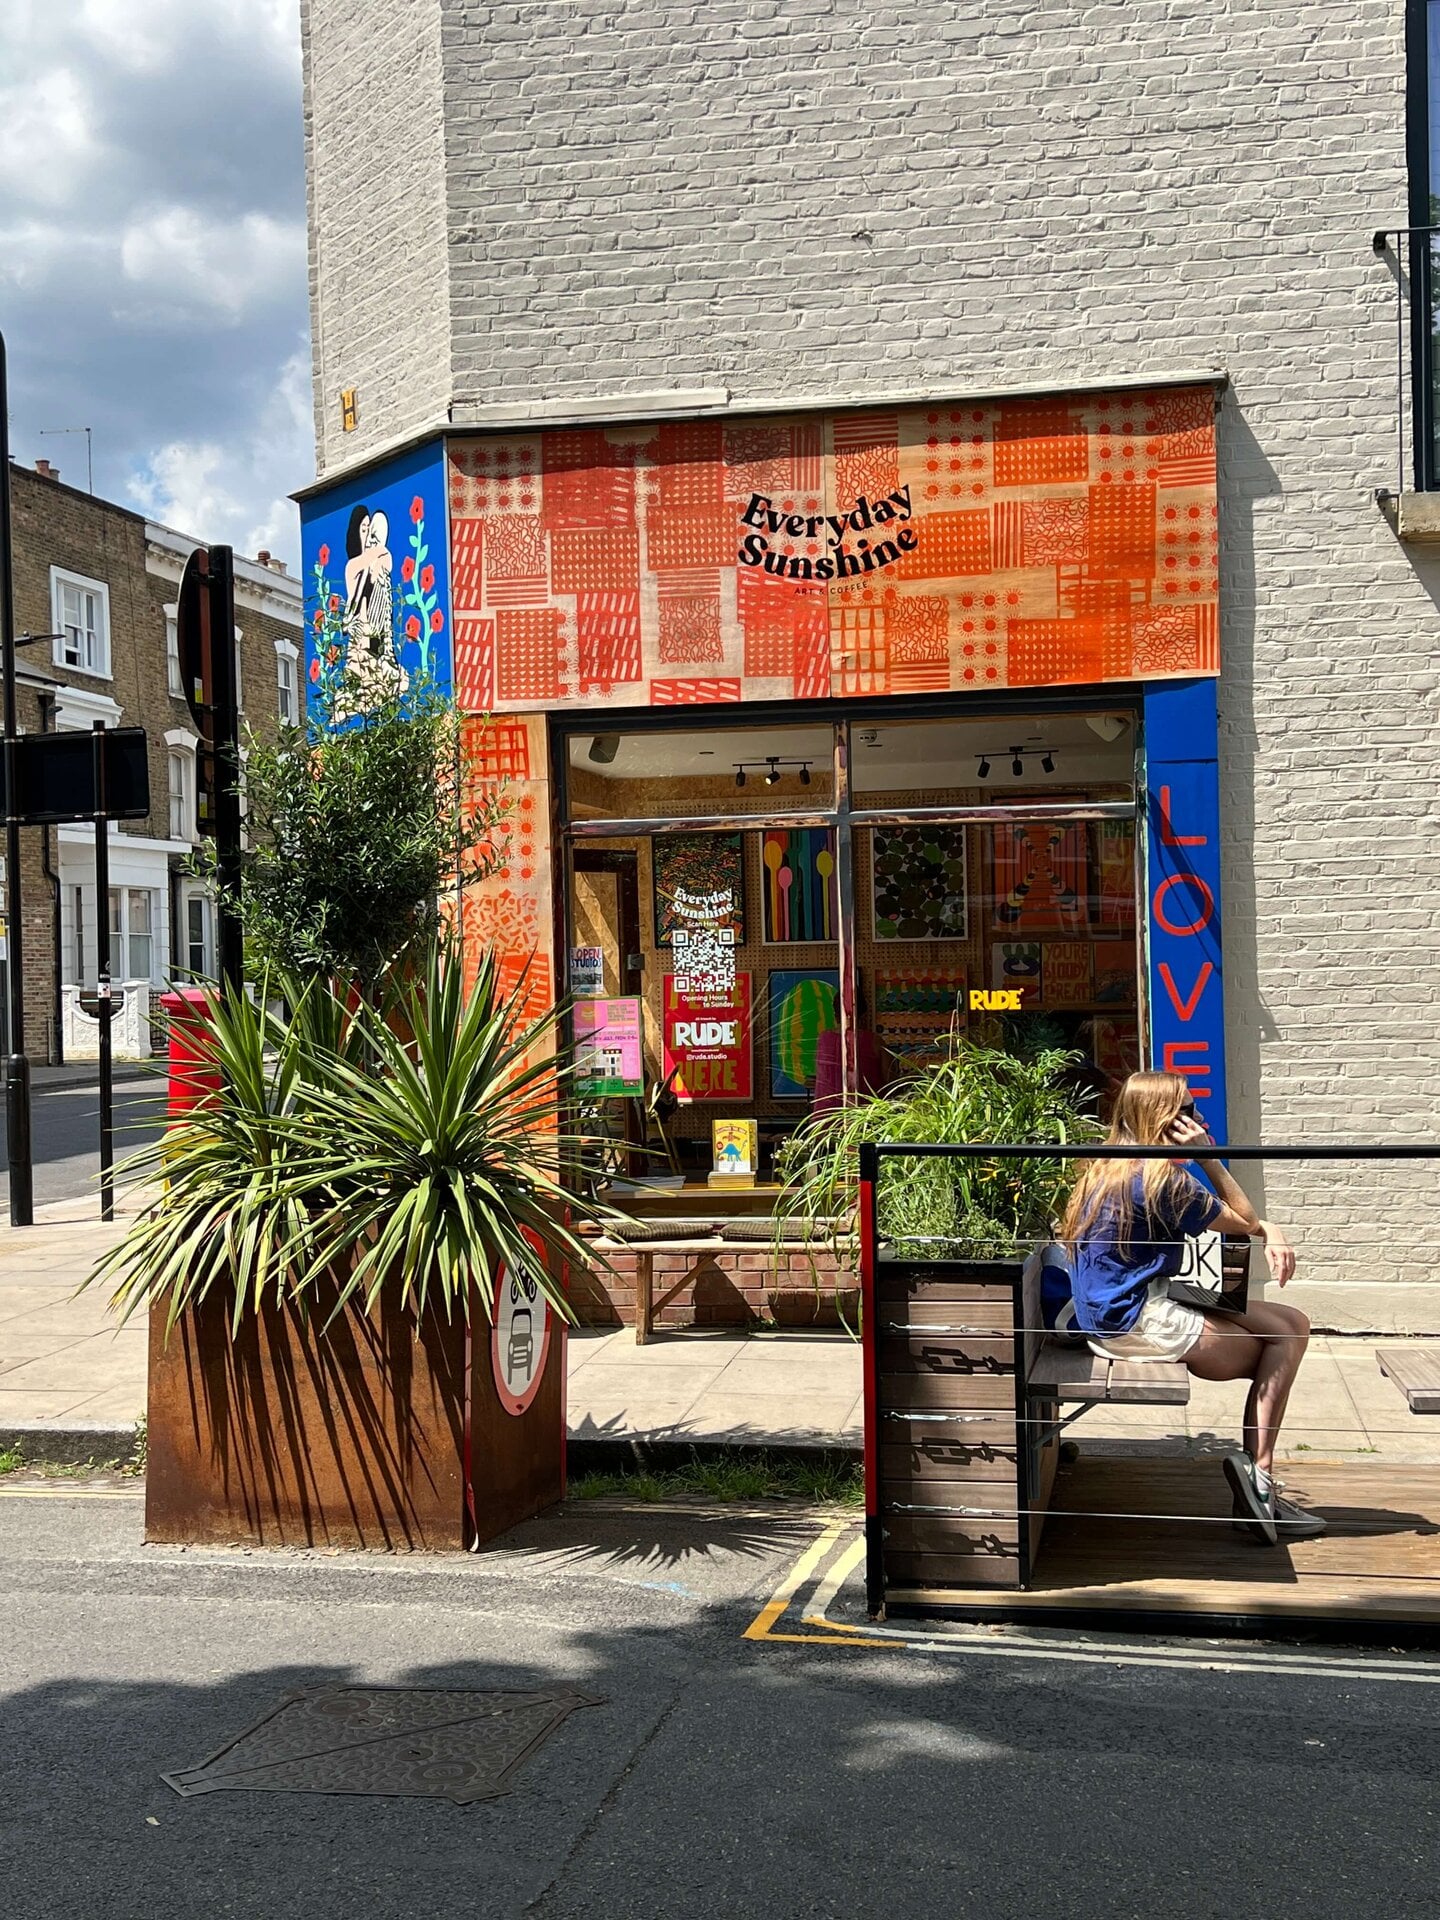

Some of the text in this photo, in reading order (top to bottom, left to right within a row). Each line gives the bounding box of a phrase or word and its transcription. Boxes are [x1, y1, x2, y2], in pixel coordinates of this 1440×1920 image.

[741, 485, 911, 546] Everyday
[738, 528, 919, 580] Sunshine
[794, 587, 813, 596] ART
[830, 581, 868, 595] COFFEE
[673, 887, 733, 908] Everyday
[671, 901, 735, 919] Sunshine
[576, 949, 600, 959] OPEN
[711, 1001, 735, 1009] Sunday
[676, 1060, 737, 1092] HERE
